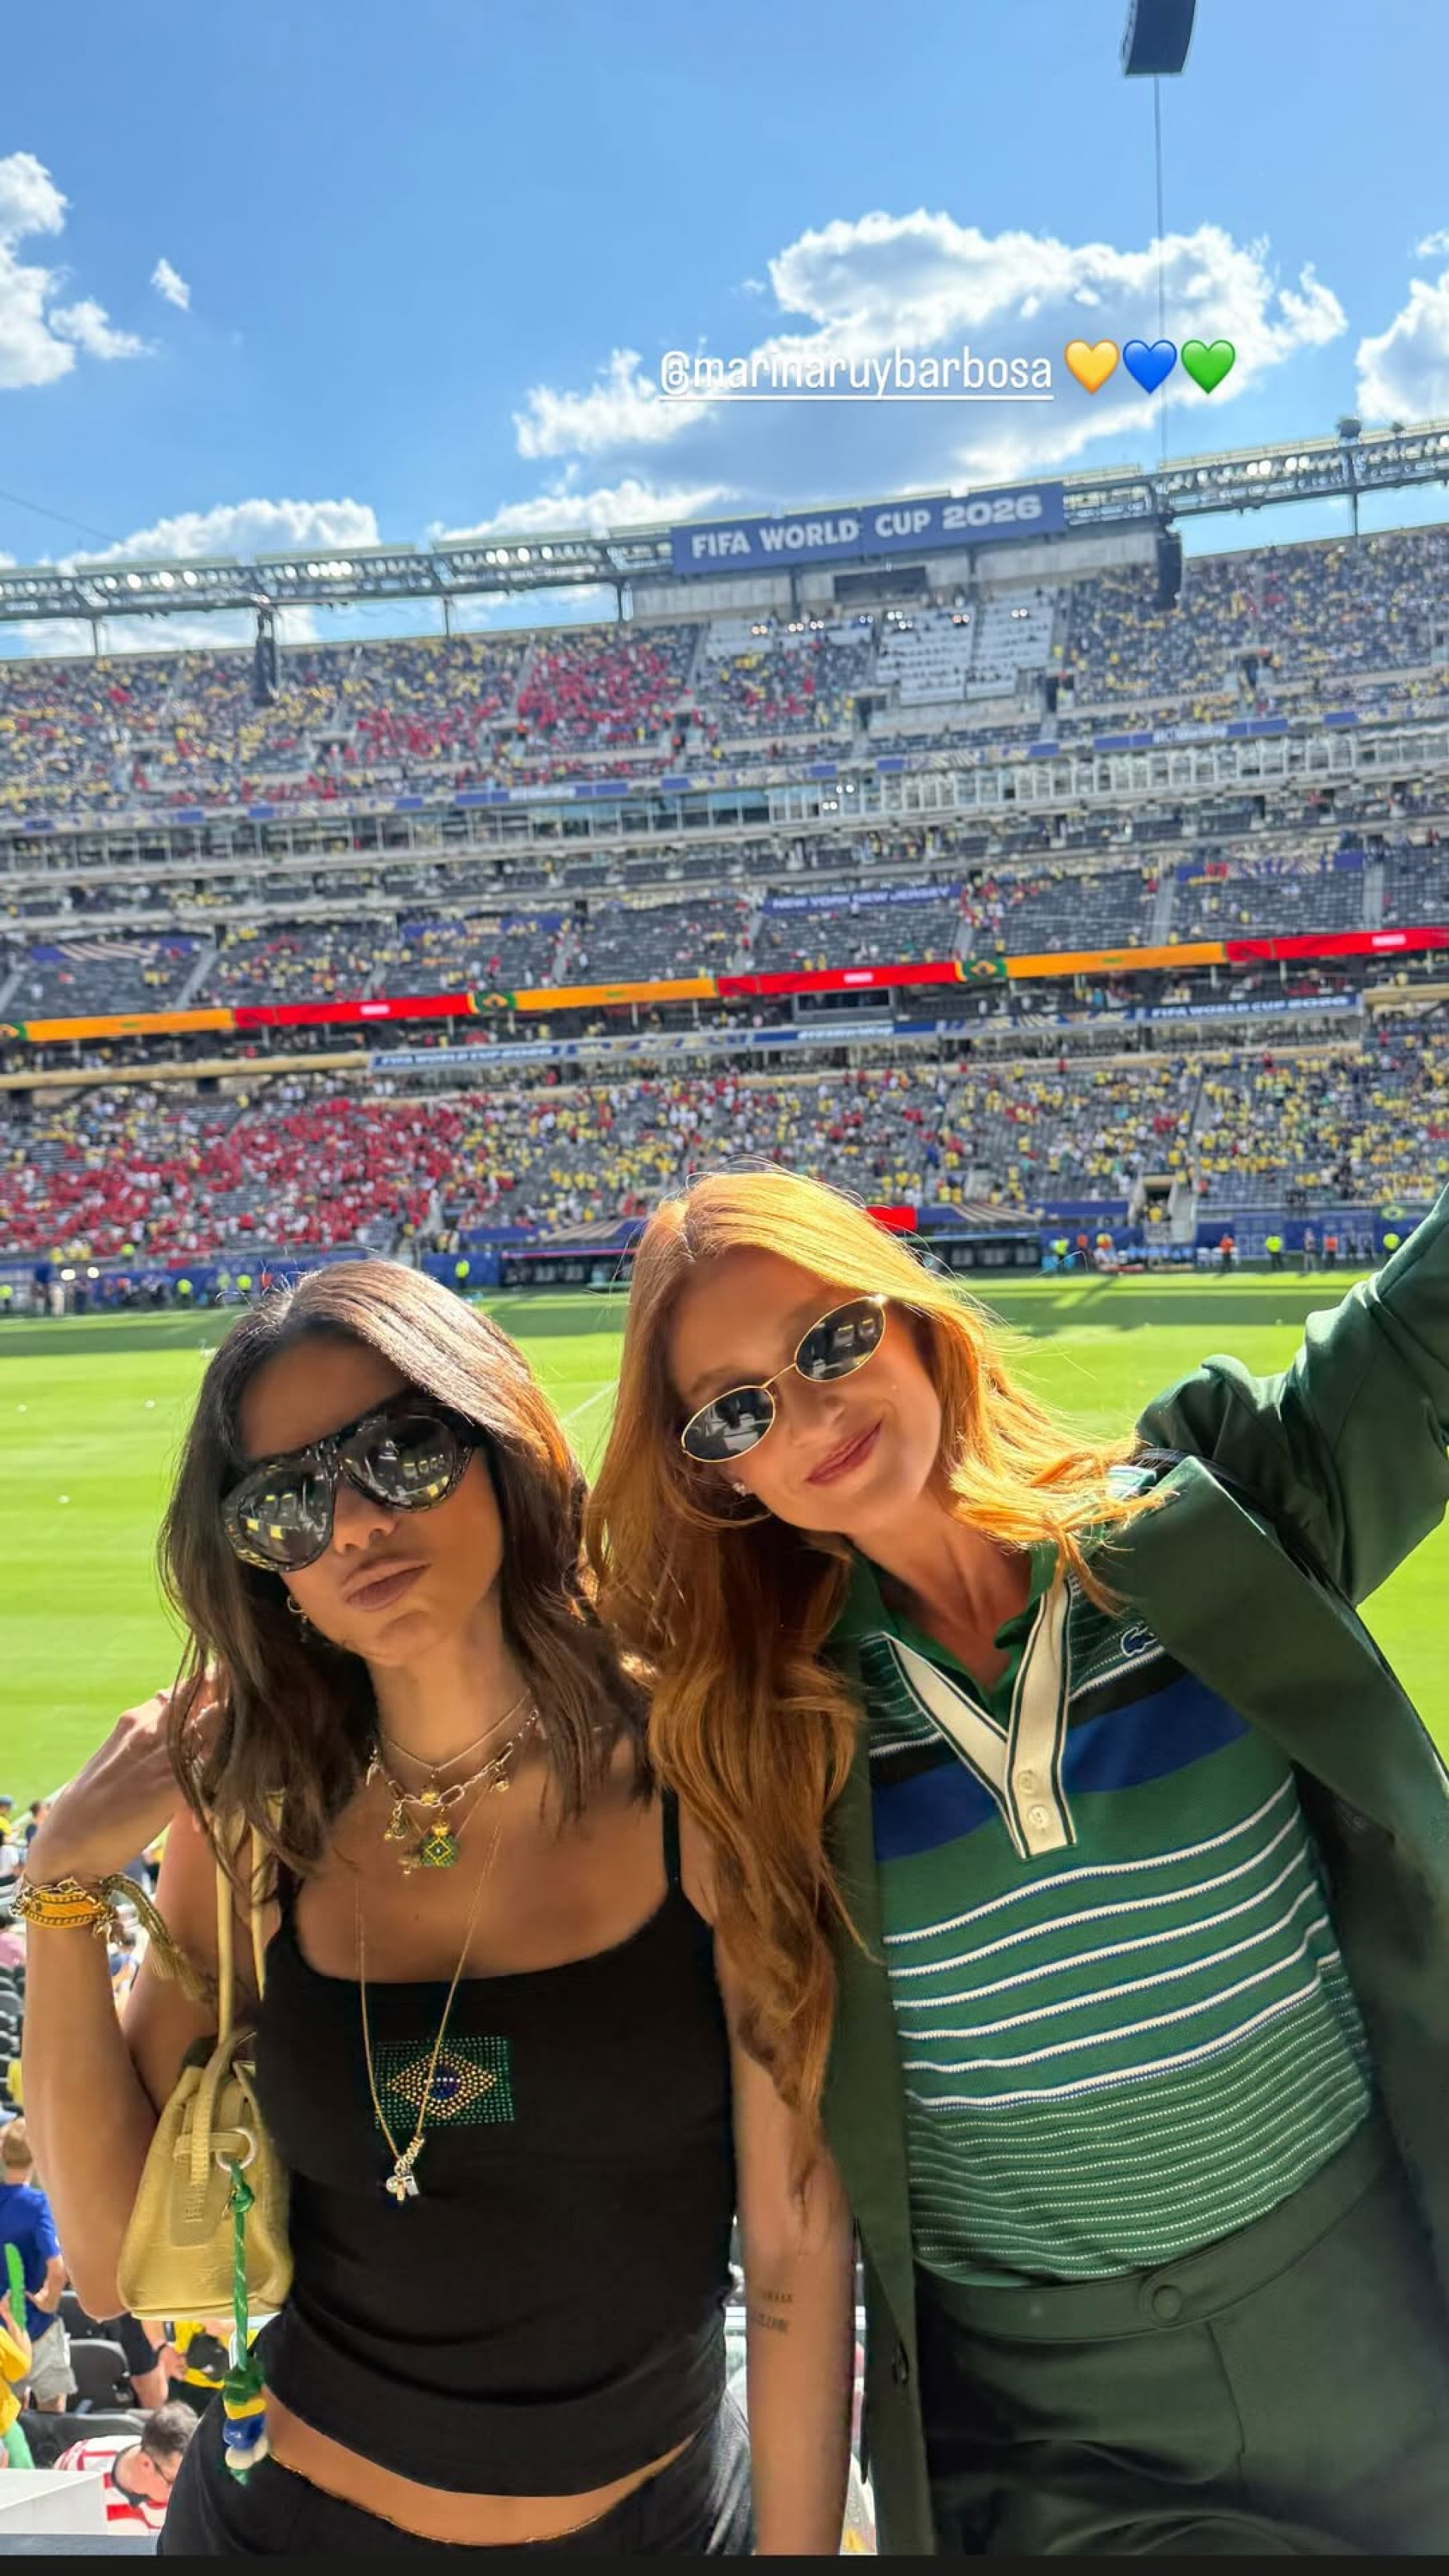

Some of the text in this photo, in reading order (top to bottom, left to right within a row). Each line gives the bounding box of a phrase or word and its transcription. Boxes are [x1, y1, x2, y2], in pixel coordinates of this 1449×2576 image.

[691, 494, 1043, 559] FIFA WORLD CUP 2026
